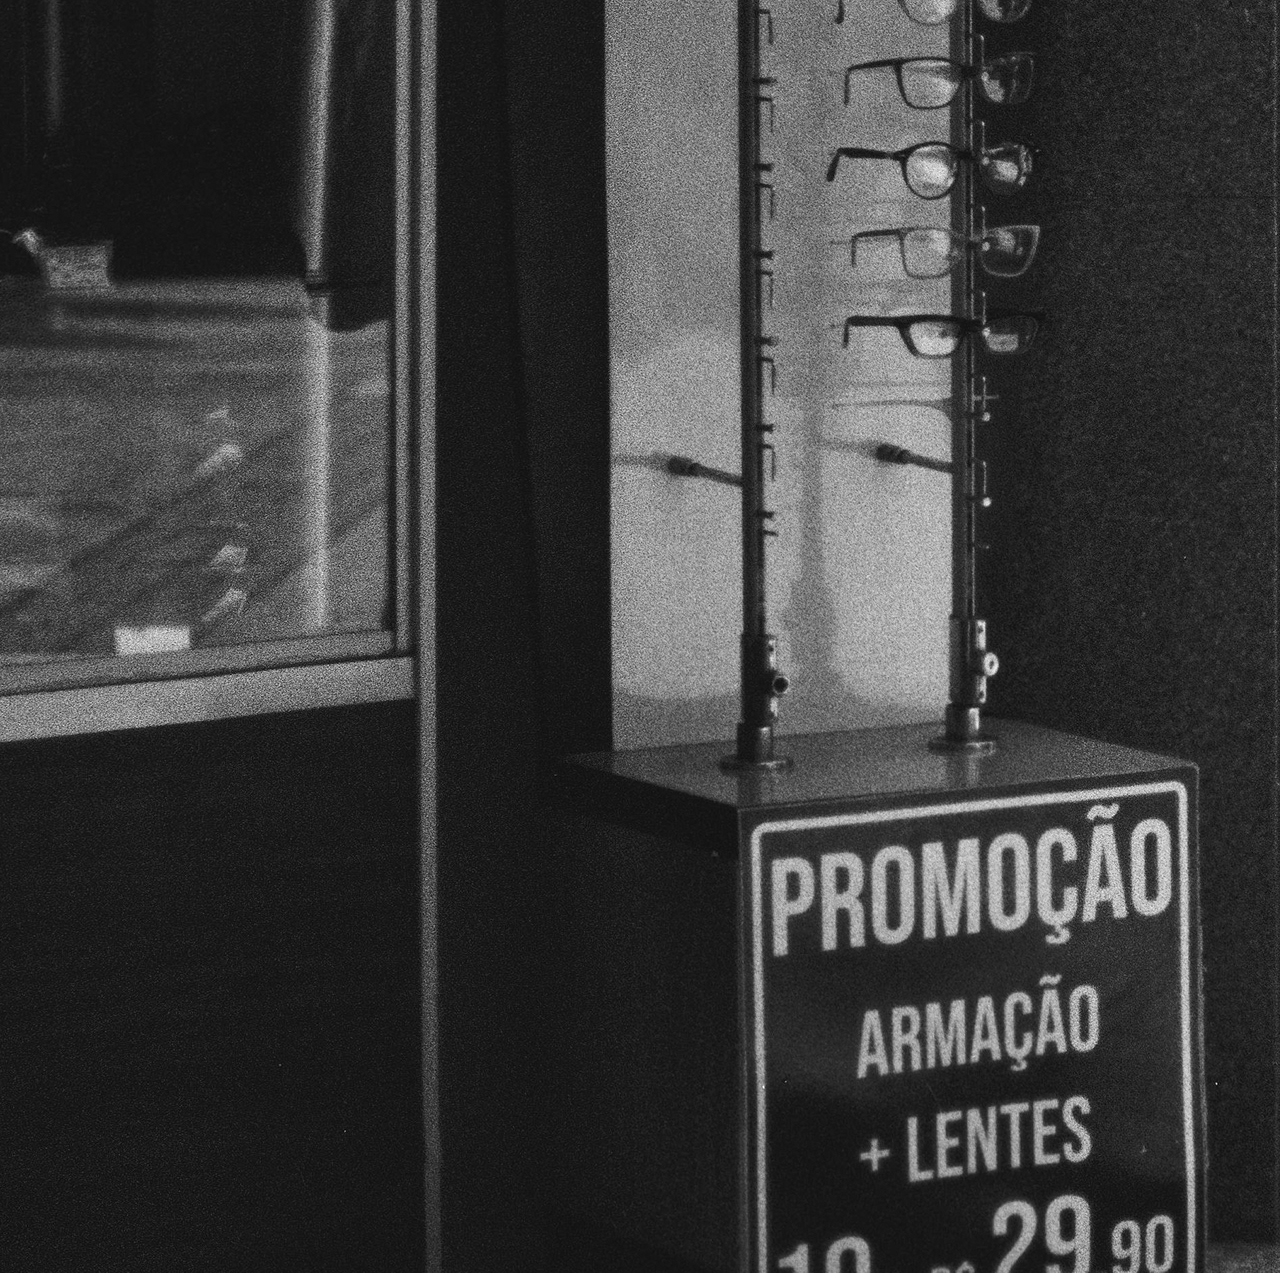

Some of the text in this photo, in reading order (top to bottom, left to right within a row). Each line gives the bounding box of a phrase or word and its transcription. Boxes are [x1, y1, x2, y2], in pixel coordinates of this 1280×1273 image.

[771, 804, 1172, 956] PROMOÇÃO
[857, 974, 1099, 1079] ARMAÇÃO
[860, 1095, 1093, 1183] + LENTES
